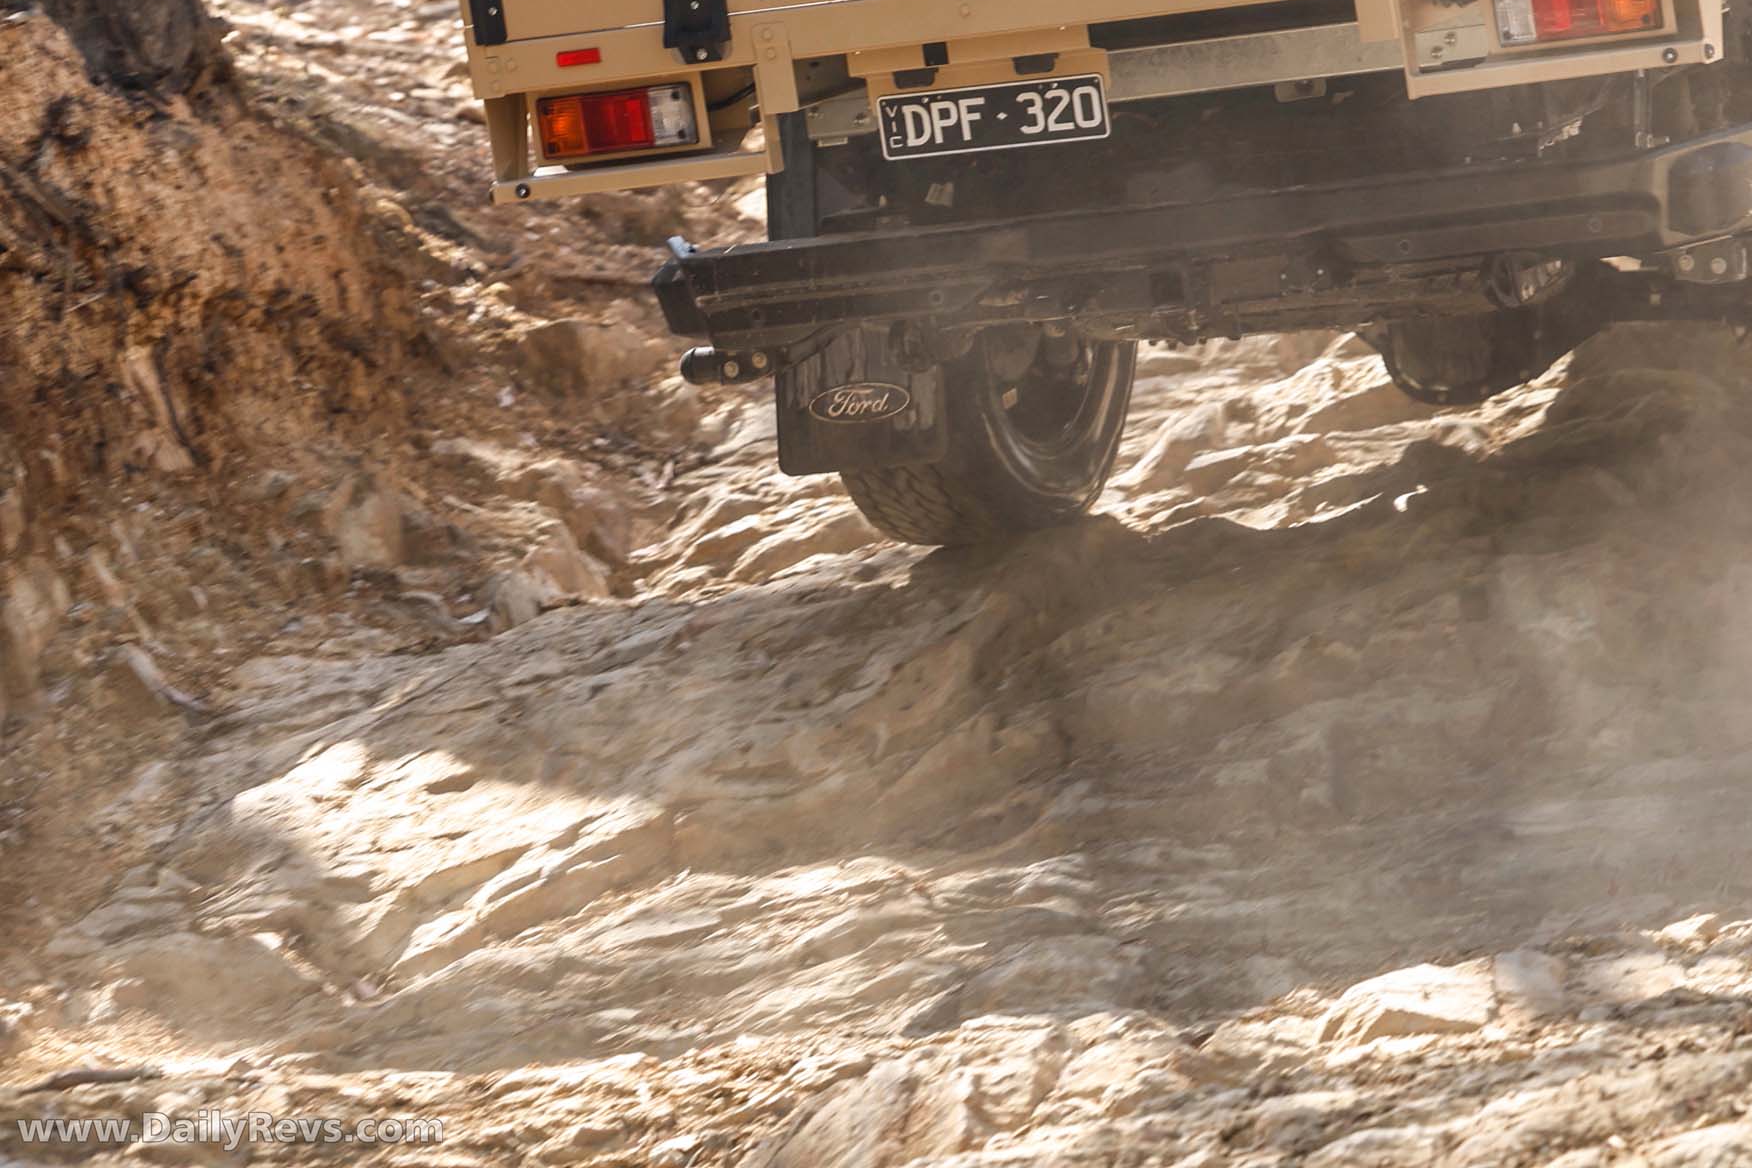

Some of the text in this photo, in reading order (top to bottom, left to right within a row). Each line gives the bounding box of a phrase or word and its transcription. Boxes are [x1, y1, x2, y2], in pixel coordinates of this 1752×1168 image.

[885, 105, 903, 149] VIC
[901, 85, 1103, 147] DPF 320
[828, 387, 888, 417] Ford
